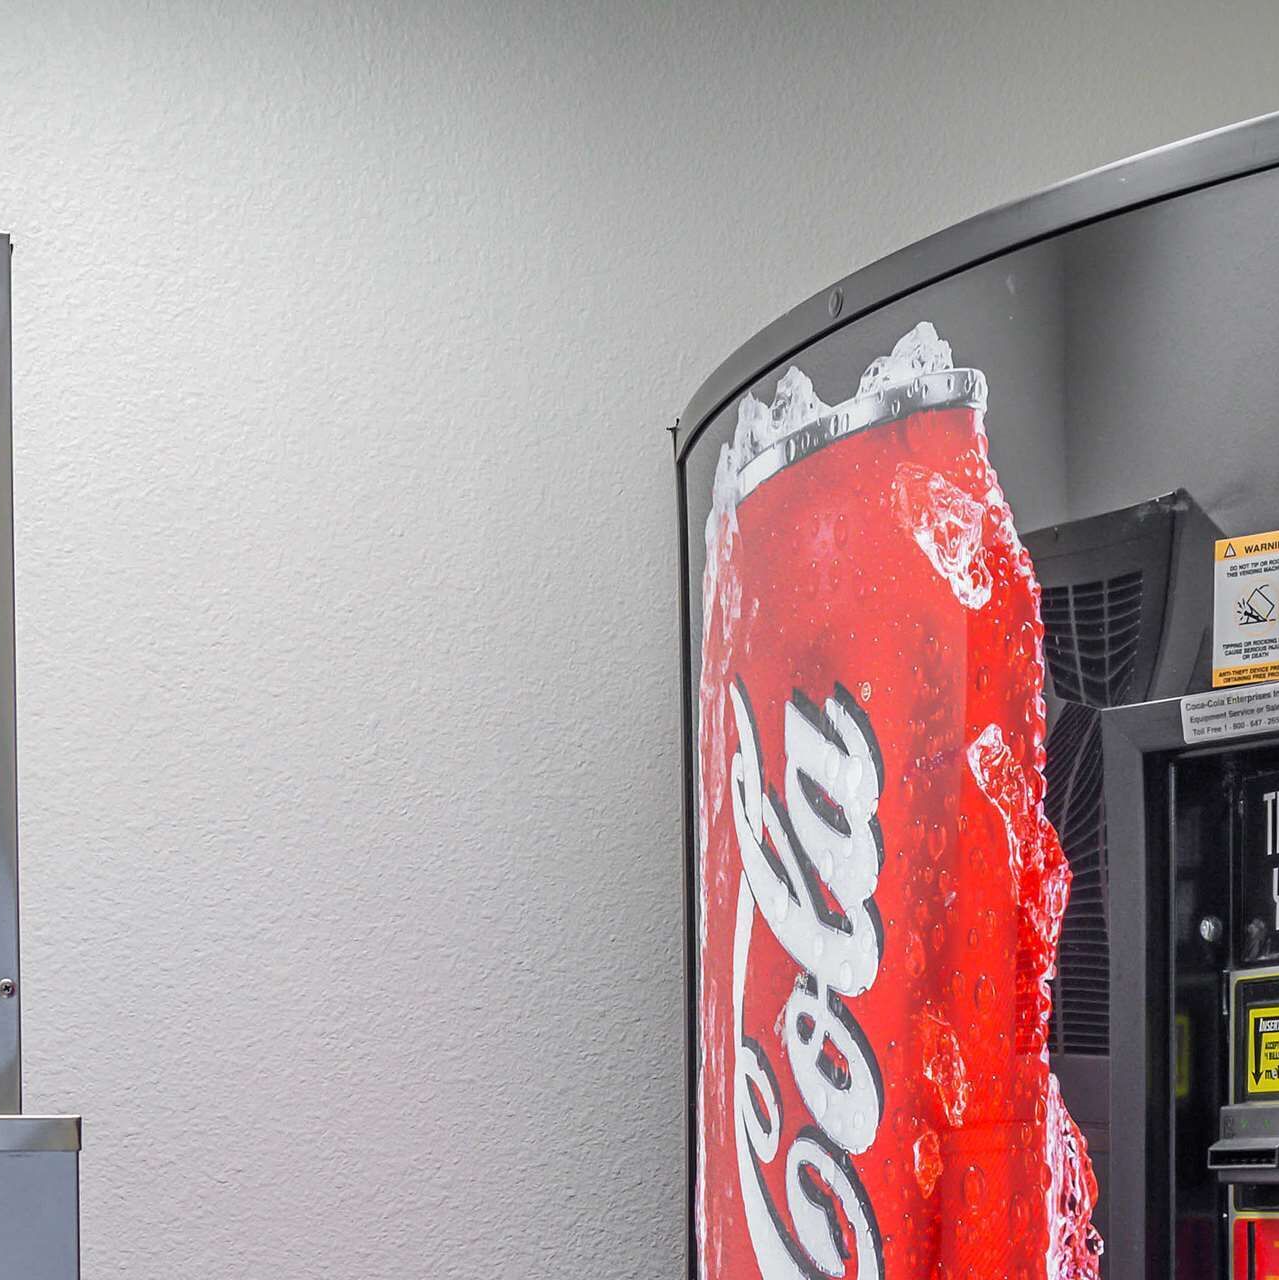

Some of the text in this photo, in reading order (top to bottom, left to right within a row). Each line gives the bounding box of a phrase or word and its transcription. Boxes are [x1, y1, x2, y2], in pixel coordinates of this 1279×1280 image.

[1229, 564, 1238, 573] DO
[1239, 562, 1250, 571] NOT
[1251, 561, 1260, 569] TIP
[1260, 560, 1269, 568] OR
[1239, 567, 1263, 577] VENDING
[1222, 640, 1243, 650] TIPPING
[1244, 639, 1253, 648] OR
[1253, 637, 1278, 647] ROCKING
[1224, 648, 1243, 657] CAUSE
[1244, 645, 1267, 655] SERIOUS
[1242, 651, 1270, 661] OR DEATH
[1218, 668, 1249, 679] ANTI-THEFT
[1249, 665, 1270, 675] DEVICE
[1252, 672, 1267, 681] FREE
[1185, 698, 1225, 711] Coca-Cola
[1226, 691, 1272, 705] Enterprises
[1189, 712, 1227, 725] Equipment
[1228, 708, 1255, 719] Service
[1255, 706, 1264, 714] or
[1192, 728, 1206, 737] Toll
[1206, 725, 1222, 735] Free
